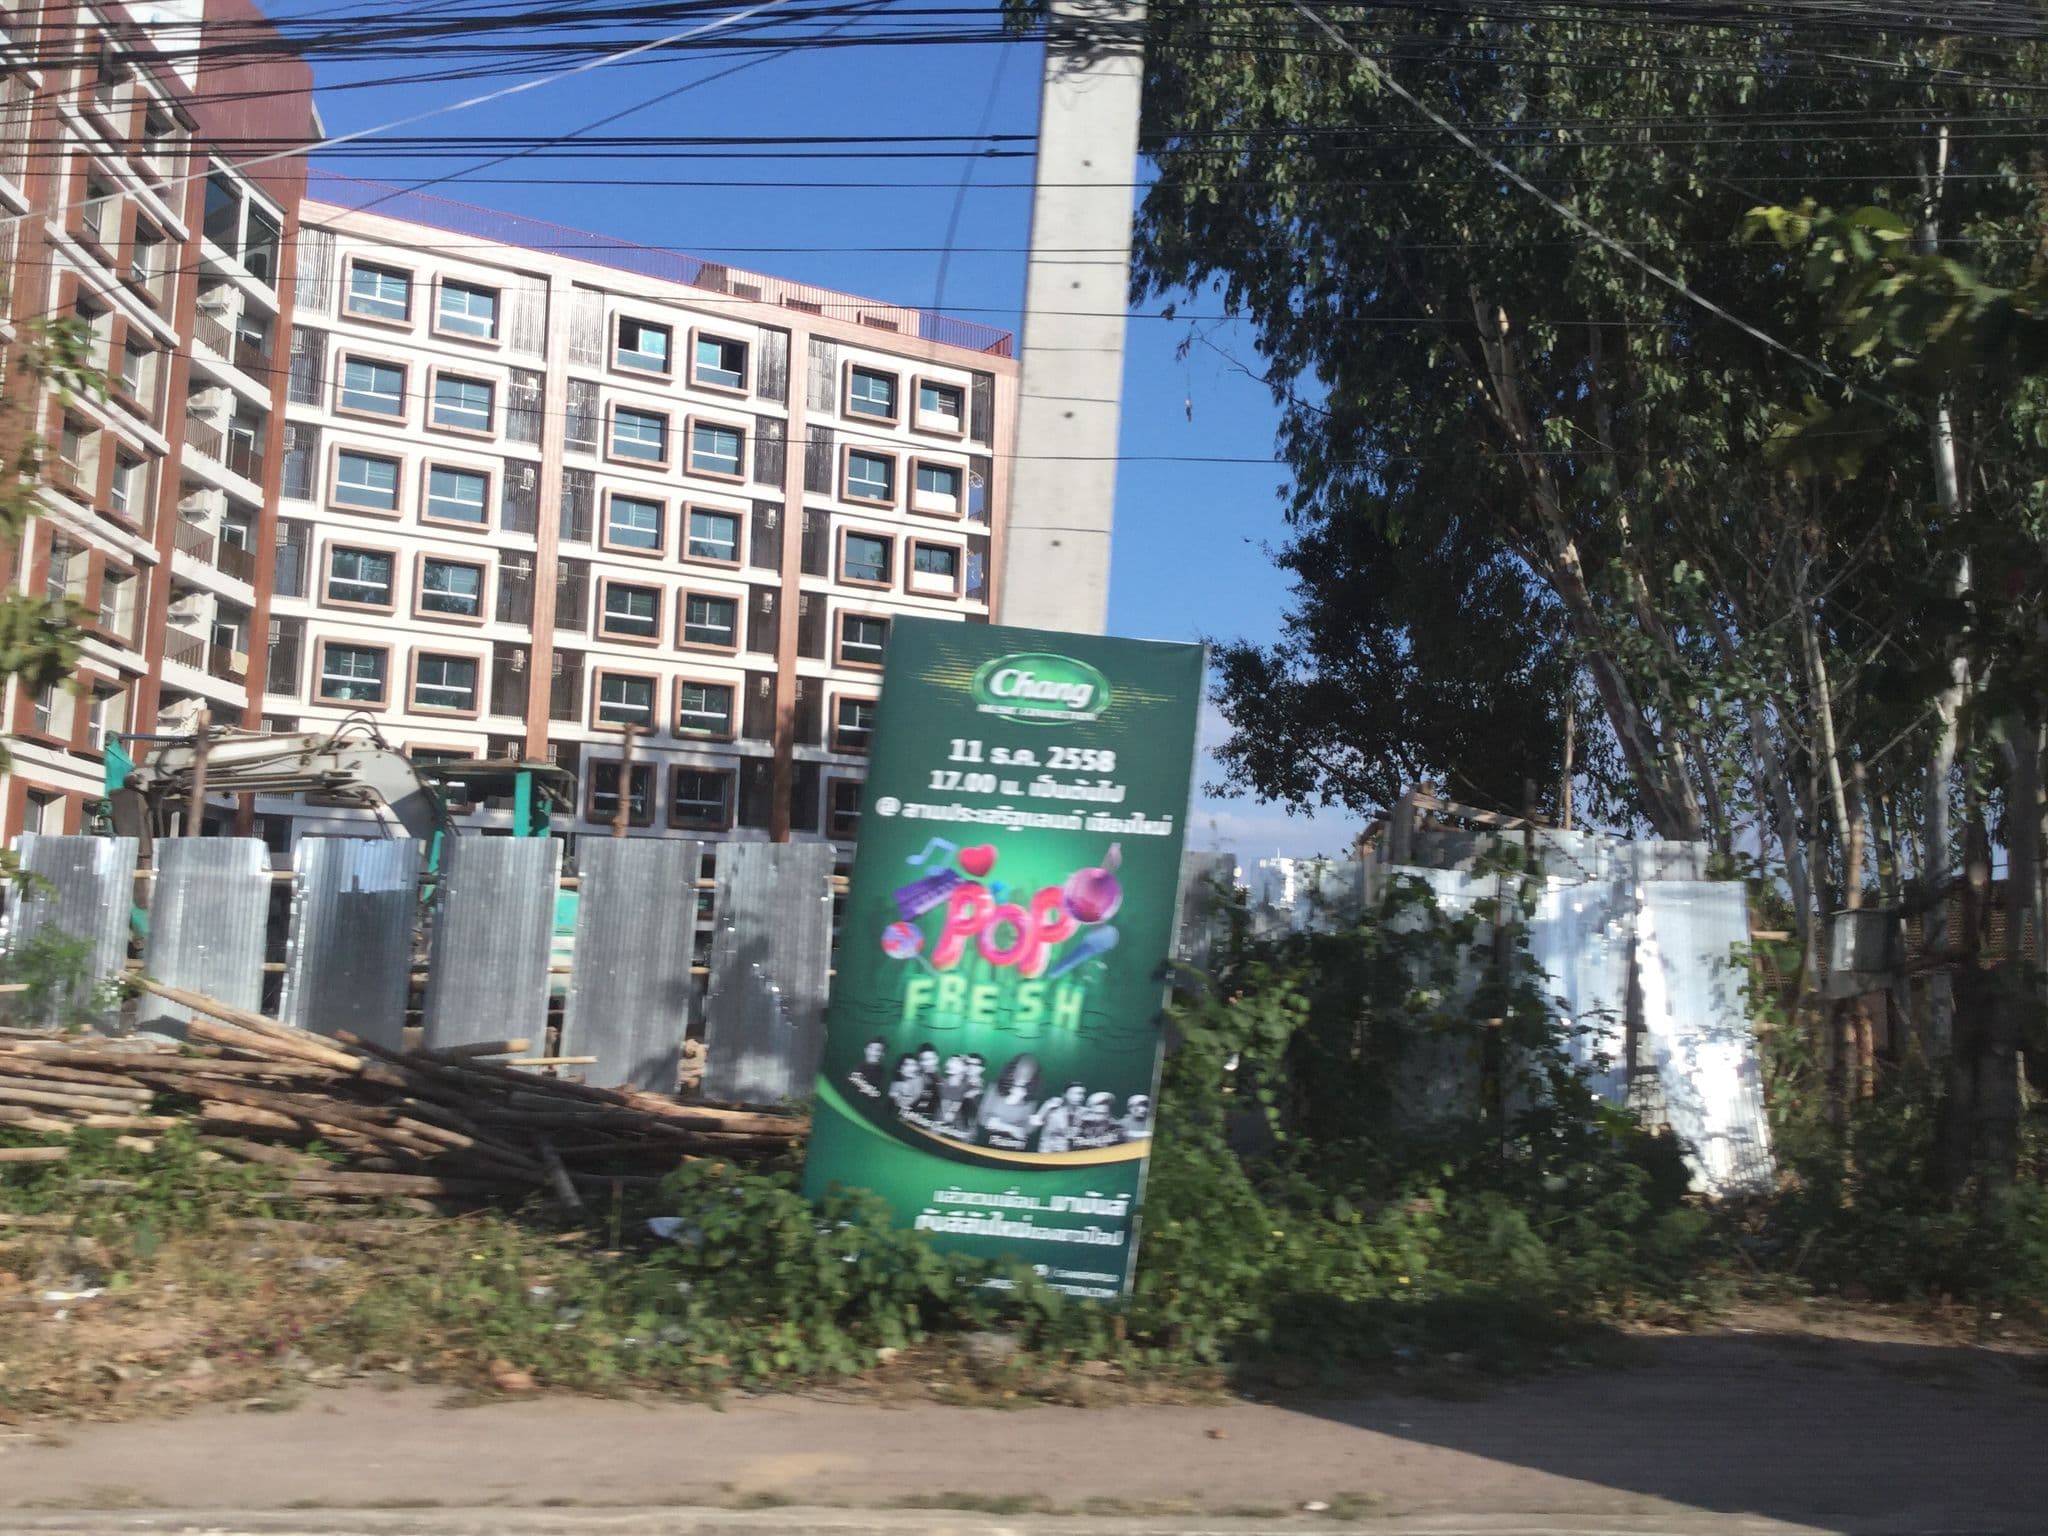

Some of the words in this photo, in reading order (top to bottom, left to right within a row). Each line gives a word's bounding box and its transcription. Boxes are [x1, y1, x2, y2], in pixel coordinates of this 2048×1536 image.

[990, 668, 1095, 709] Chang
[948, 738, 984, 762] 11
[1046, 746, 1117, 773] 2558
[928, 769, 997, 794] 17.00
[931, 880, 1082, 979] POP
[902, 972, 1087, 1032] FRESH
